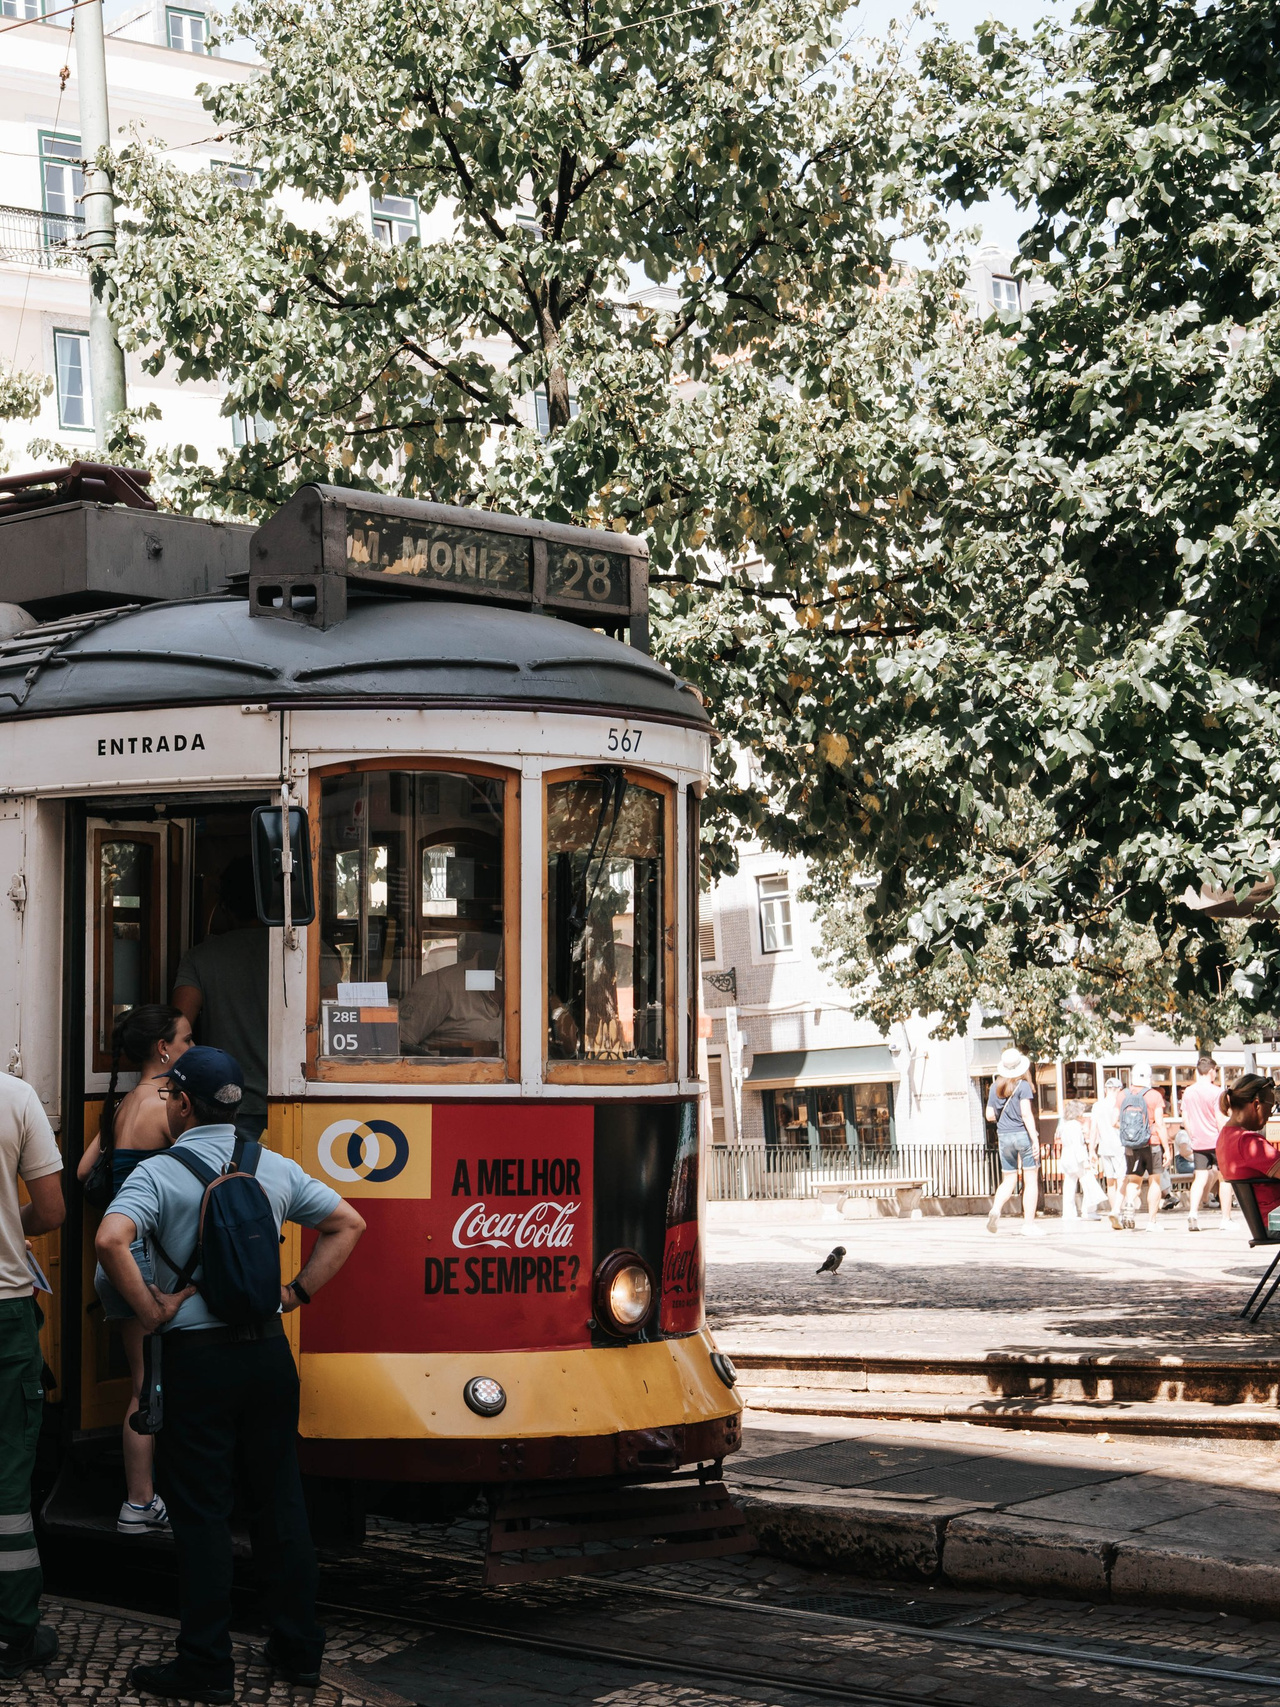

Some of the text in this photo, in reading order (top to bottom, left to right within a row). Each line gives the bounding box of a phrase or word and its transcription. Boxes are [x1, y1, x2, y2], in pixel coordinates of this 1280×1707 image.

[402, 536, 509, 583] MONIZ
[559, 549, 612, 600] 28
[97, 733, 206, 756] ENTRADA
[607, 727, 643, 753] 567
[332, 1011, 358, 1023] 28E
[332, 1033, 359, 1051] 05
[451, 1158, 581, 1197] A MELHOR
[451, 1201, 582, 1249] Coca-Cola
[424, 1255, 581, 1295] DE SEMPRE?
